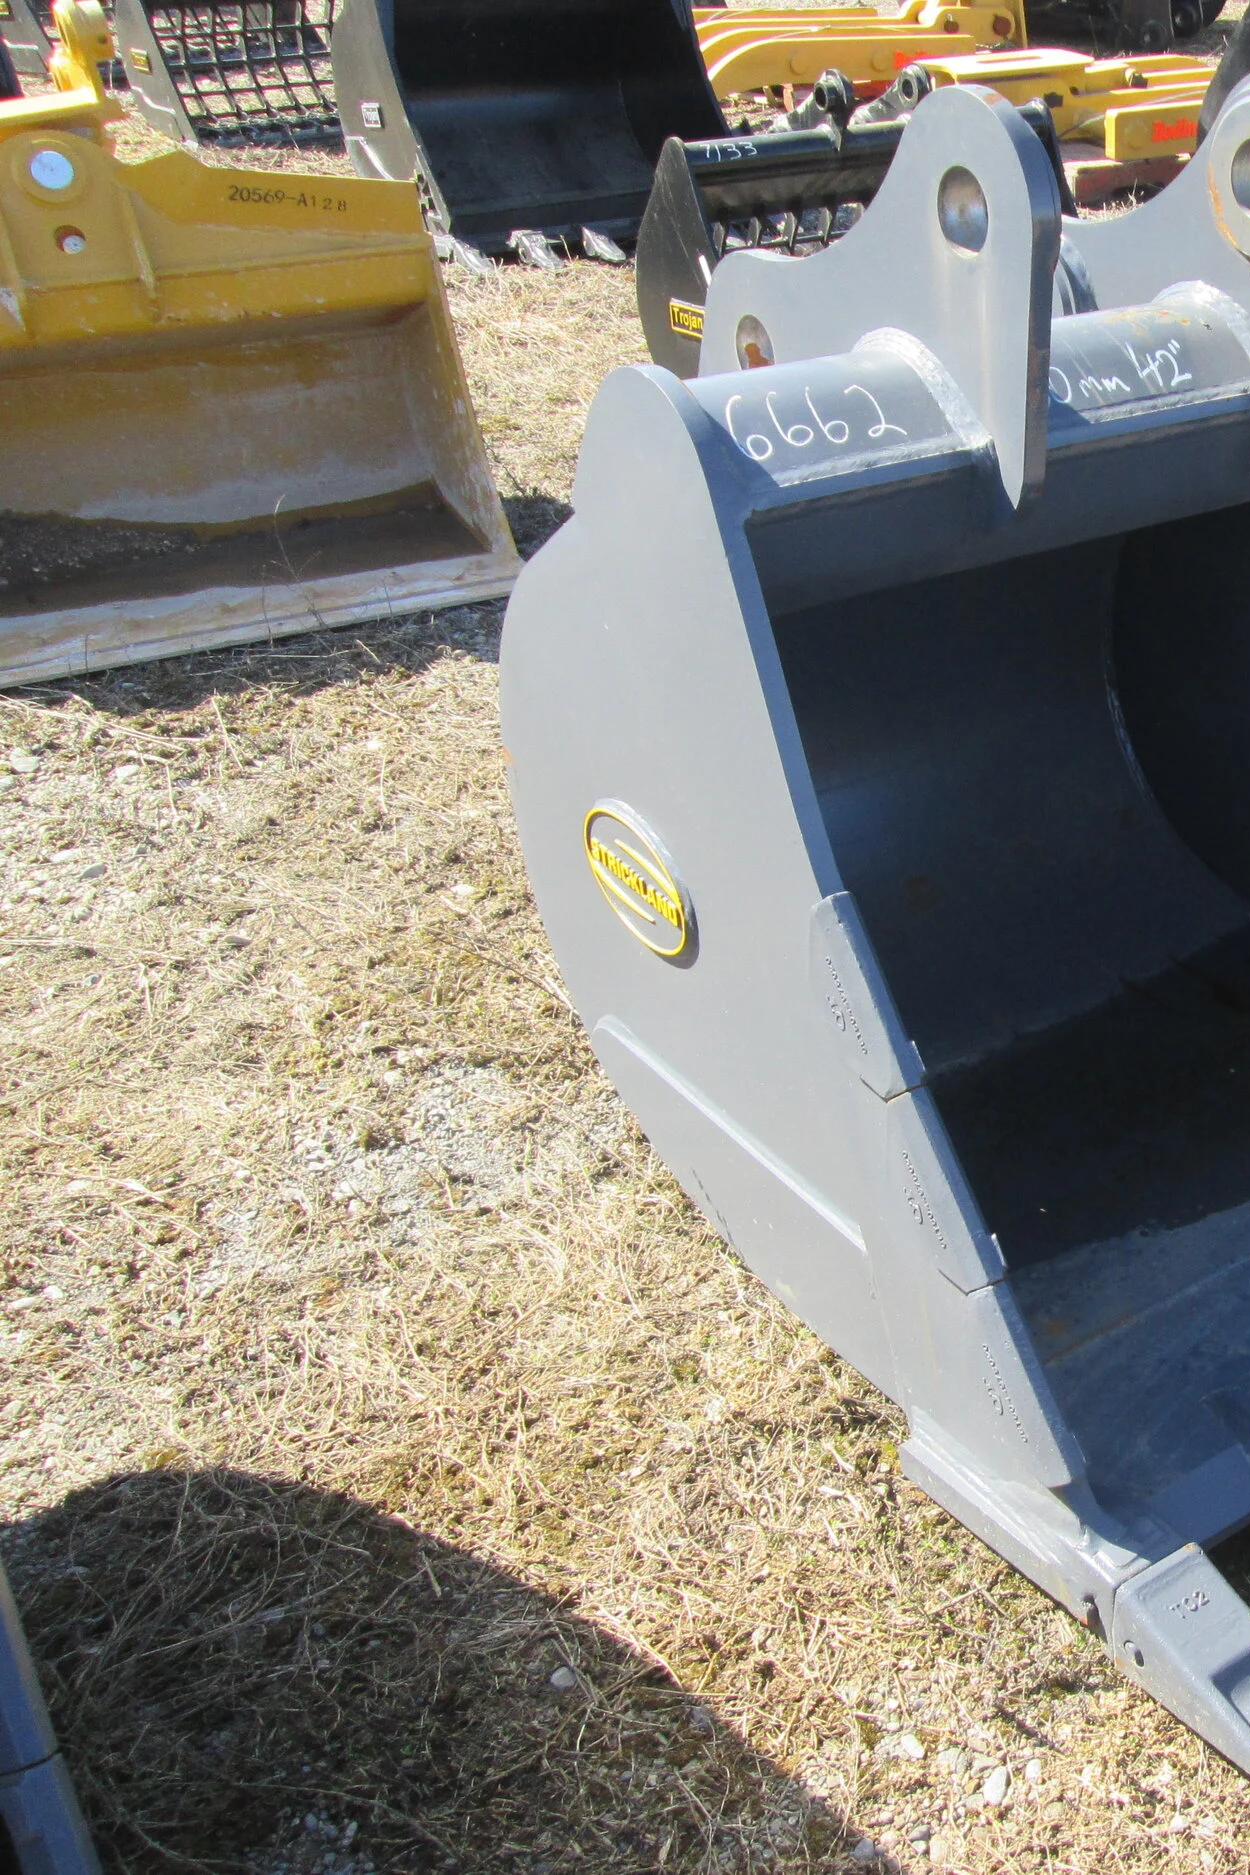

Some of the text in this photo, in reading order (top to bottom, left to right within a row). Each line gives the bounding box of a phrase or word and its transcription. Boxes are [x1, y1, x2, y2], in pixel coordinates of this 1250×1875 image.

[699, 141, 758, 162] 7133
[672, 307, 704, 331] Trojan
[725, 383, 908, 461] 6662
[589, 836, 681, 928] STRICKLAND
